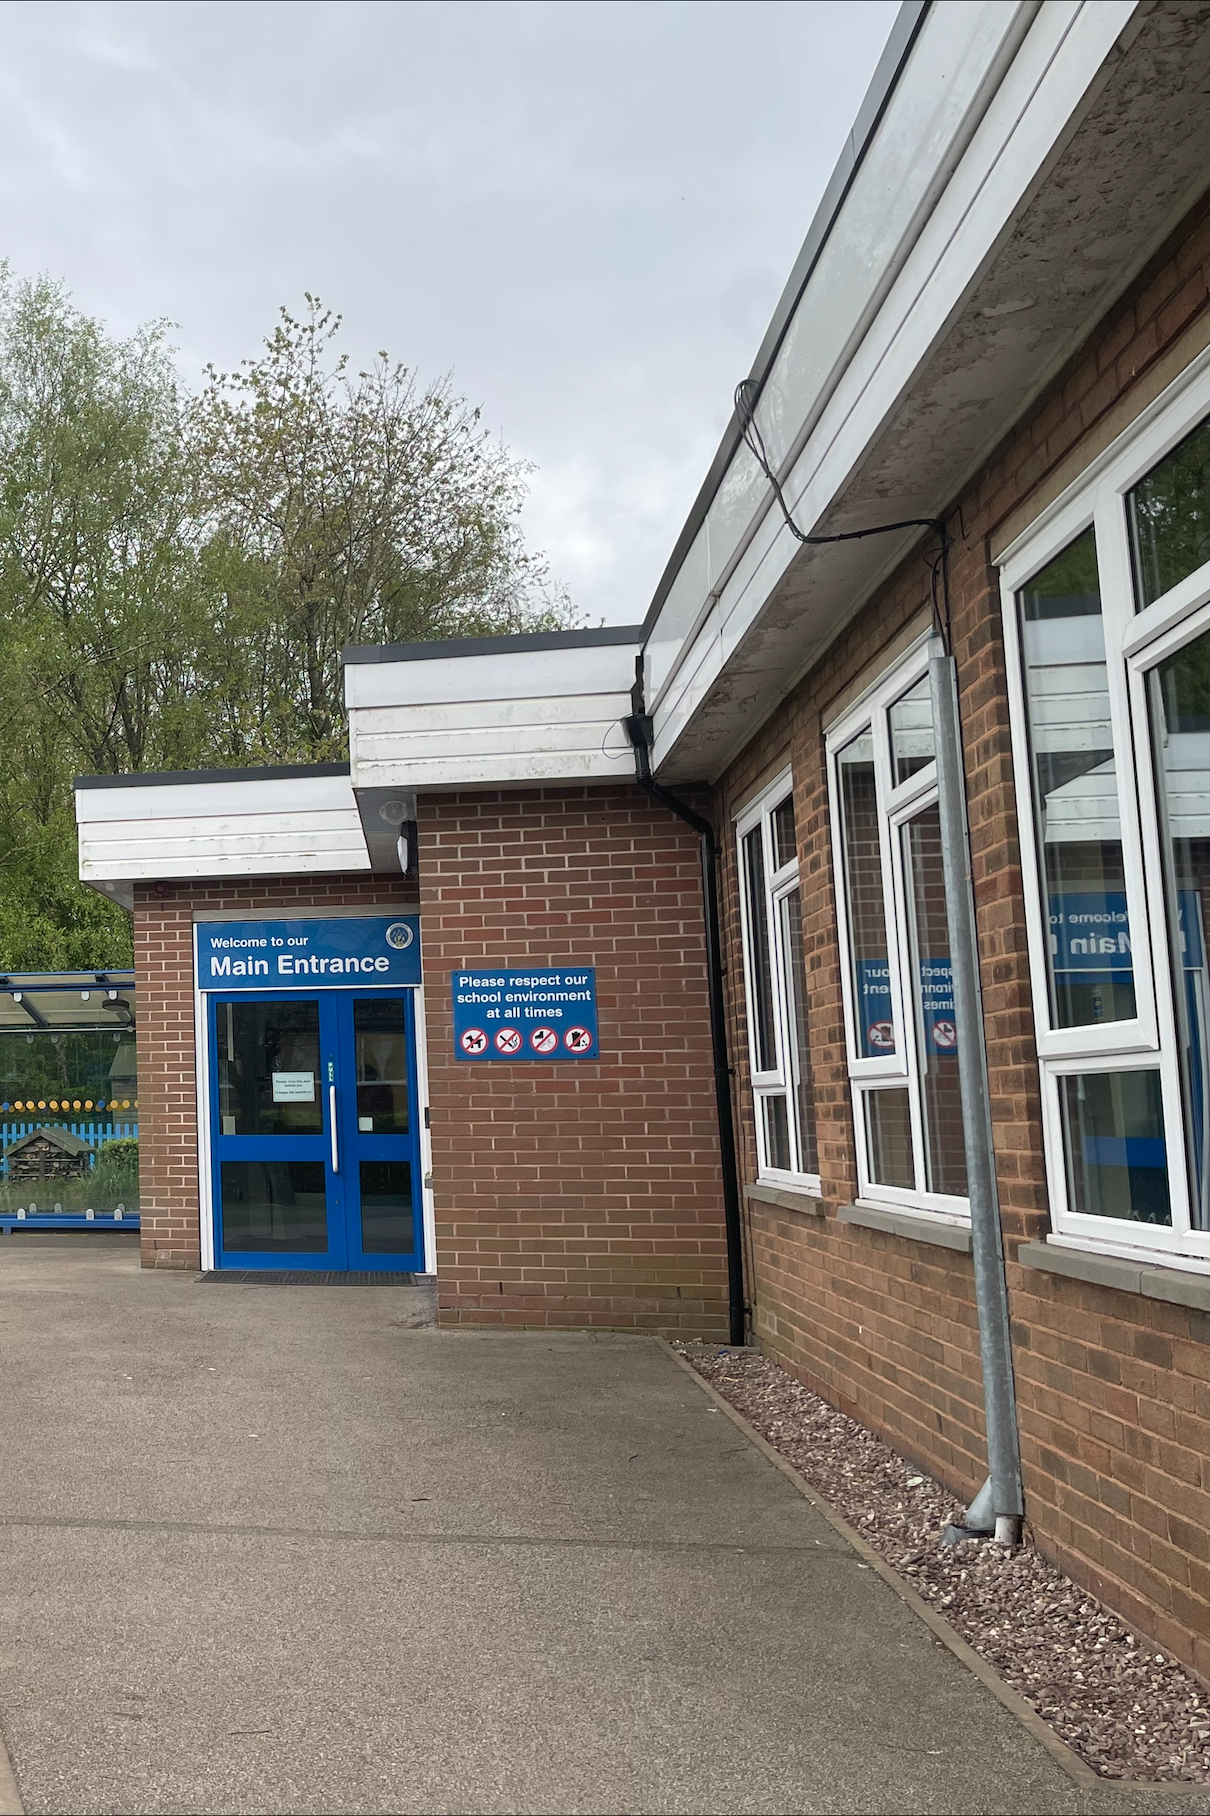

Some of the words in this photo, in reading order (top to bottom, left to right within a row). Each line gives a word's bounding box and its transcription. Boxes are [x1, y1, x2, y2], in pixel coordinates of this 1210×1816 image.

[210, 936, 268, 948] Welcome
[271, 936, 284, 947] to
[287, 936, 308, 947] our
[210, 956, 269, 977] Main
[277, 954, 390, 975] Entrance
[459, 976, 505, 988] Please
[509, 975, 561, 988] respect
[565, 976, 588, 986] our
[457, 991, 501, 1003] school
[505, 989, 592, 1002] environment
[486, 1007, 501, 1018] at
[504, 1007, 520, 1018] all
[524, 1006, 563, 1018] times
